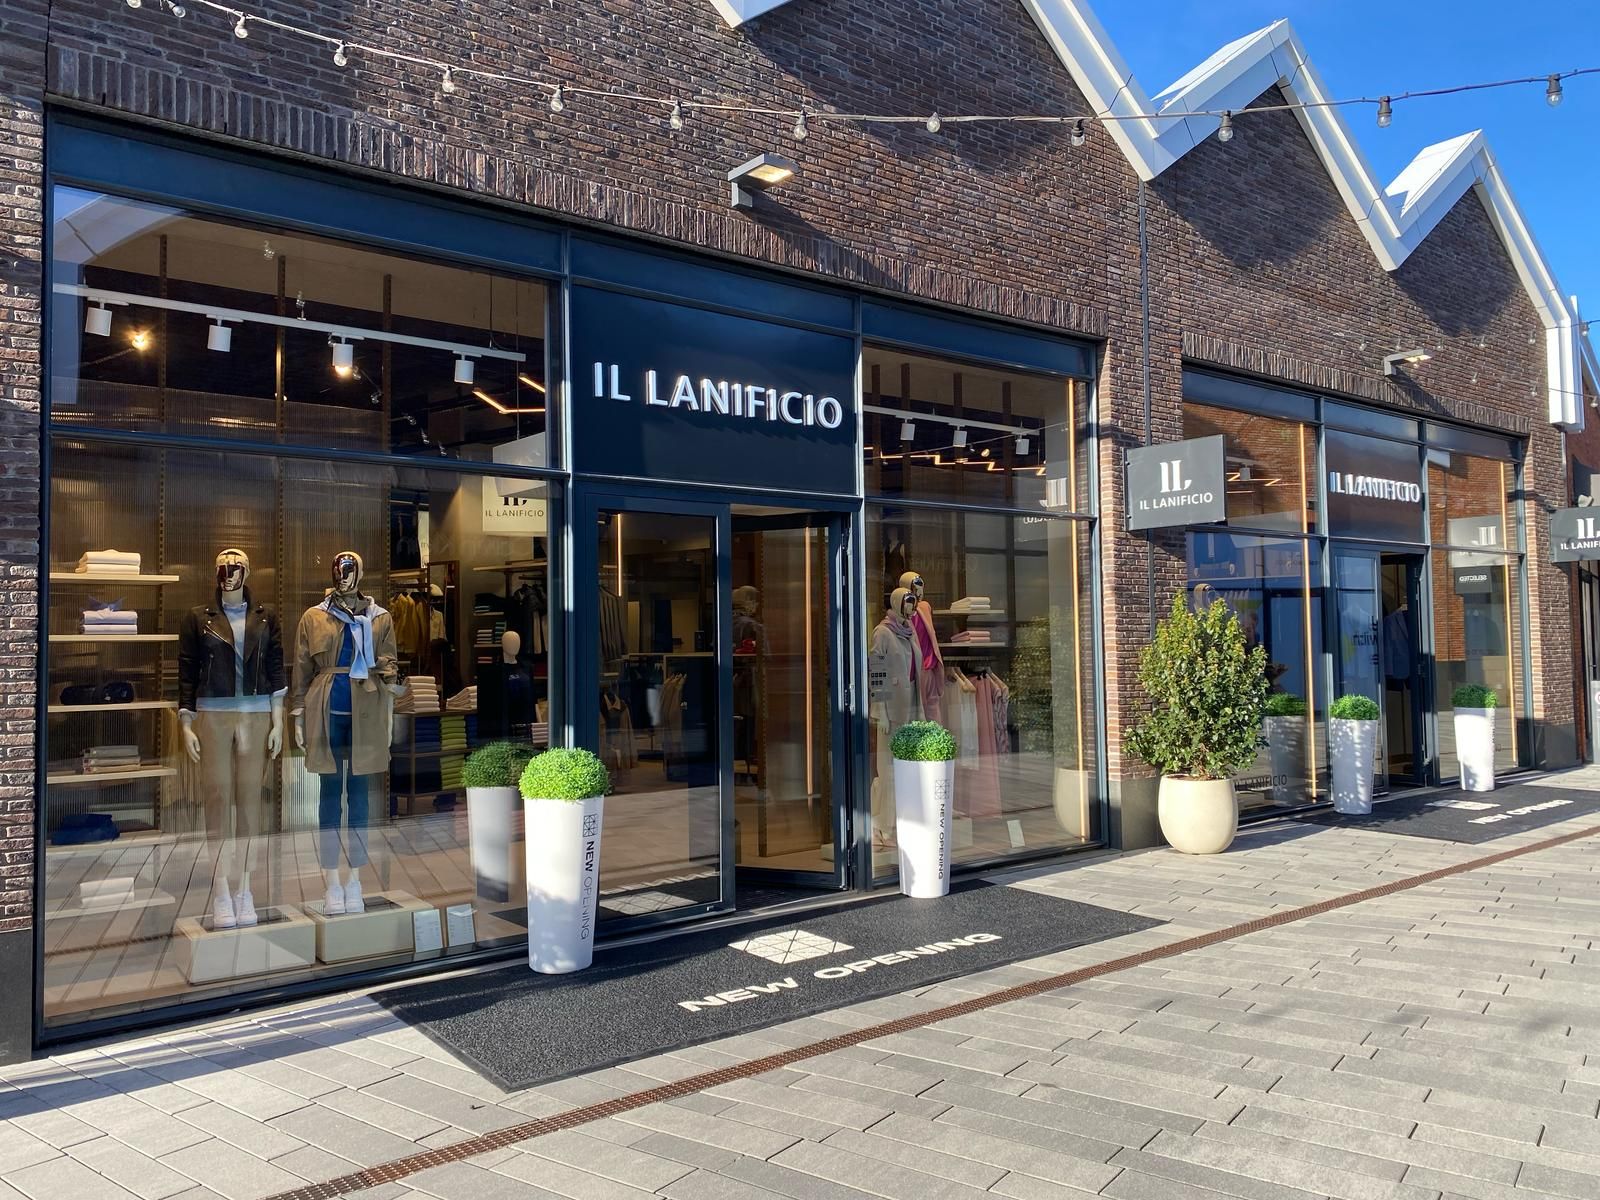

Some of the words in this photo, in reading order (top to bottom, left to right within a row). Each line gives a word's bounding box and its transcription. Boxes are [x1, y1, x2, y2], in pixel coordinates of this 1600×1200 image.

[594, 362, 631, 401] IL
[645, 370, 843, 429] LANIFICIO
[1140, 500, 1151, 511] IL
[1153, 492, 1213, 509] LANIFICIO
[1329, 471, 1345, 493] IL
[1345, 474, 1421, 503] LANIFICIO
[496, 509, 544, 517] LANIFICIO
[1560, 542, 1569, 550] IL
[1571, 540, 1600, 550] LANIF
[585, 841, 595, 872] NEW
[580, 876, 593, 940] OPENING
[677, 977, 799, 1012] NEW
[813, 932, 1002, 979] OPENING
